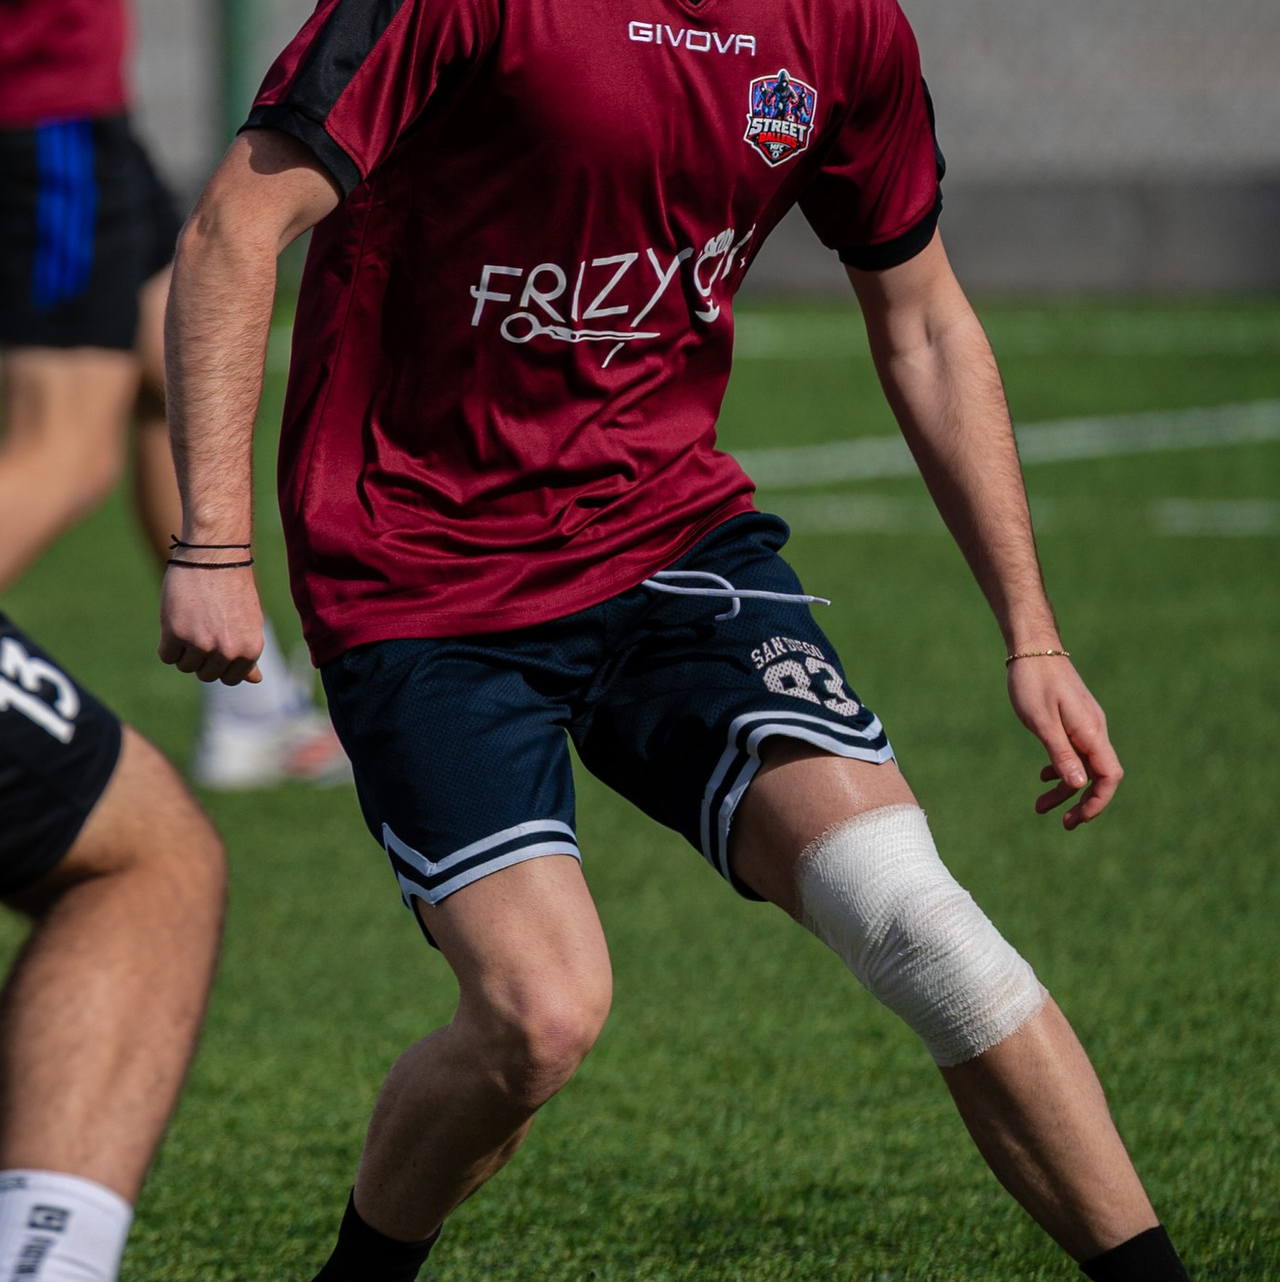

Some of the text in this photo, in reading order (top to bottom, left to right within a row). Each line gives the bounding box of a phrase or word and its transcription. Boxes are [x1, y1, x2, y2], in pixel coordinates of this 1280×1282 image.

[628, 21, 757, 56] GIVOVA
[749, 118, 807, 142] STREET
[758, 132, 798, 149] BALLERS
[751, 637, 787, 670] SAN
